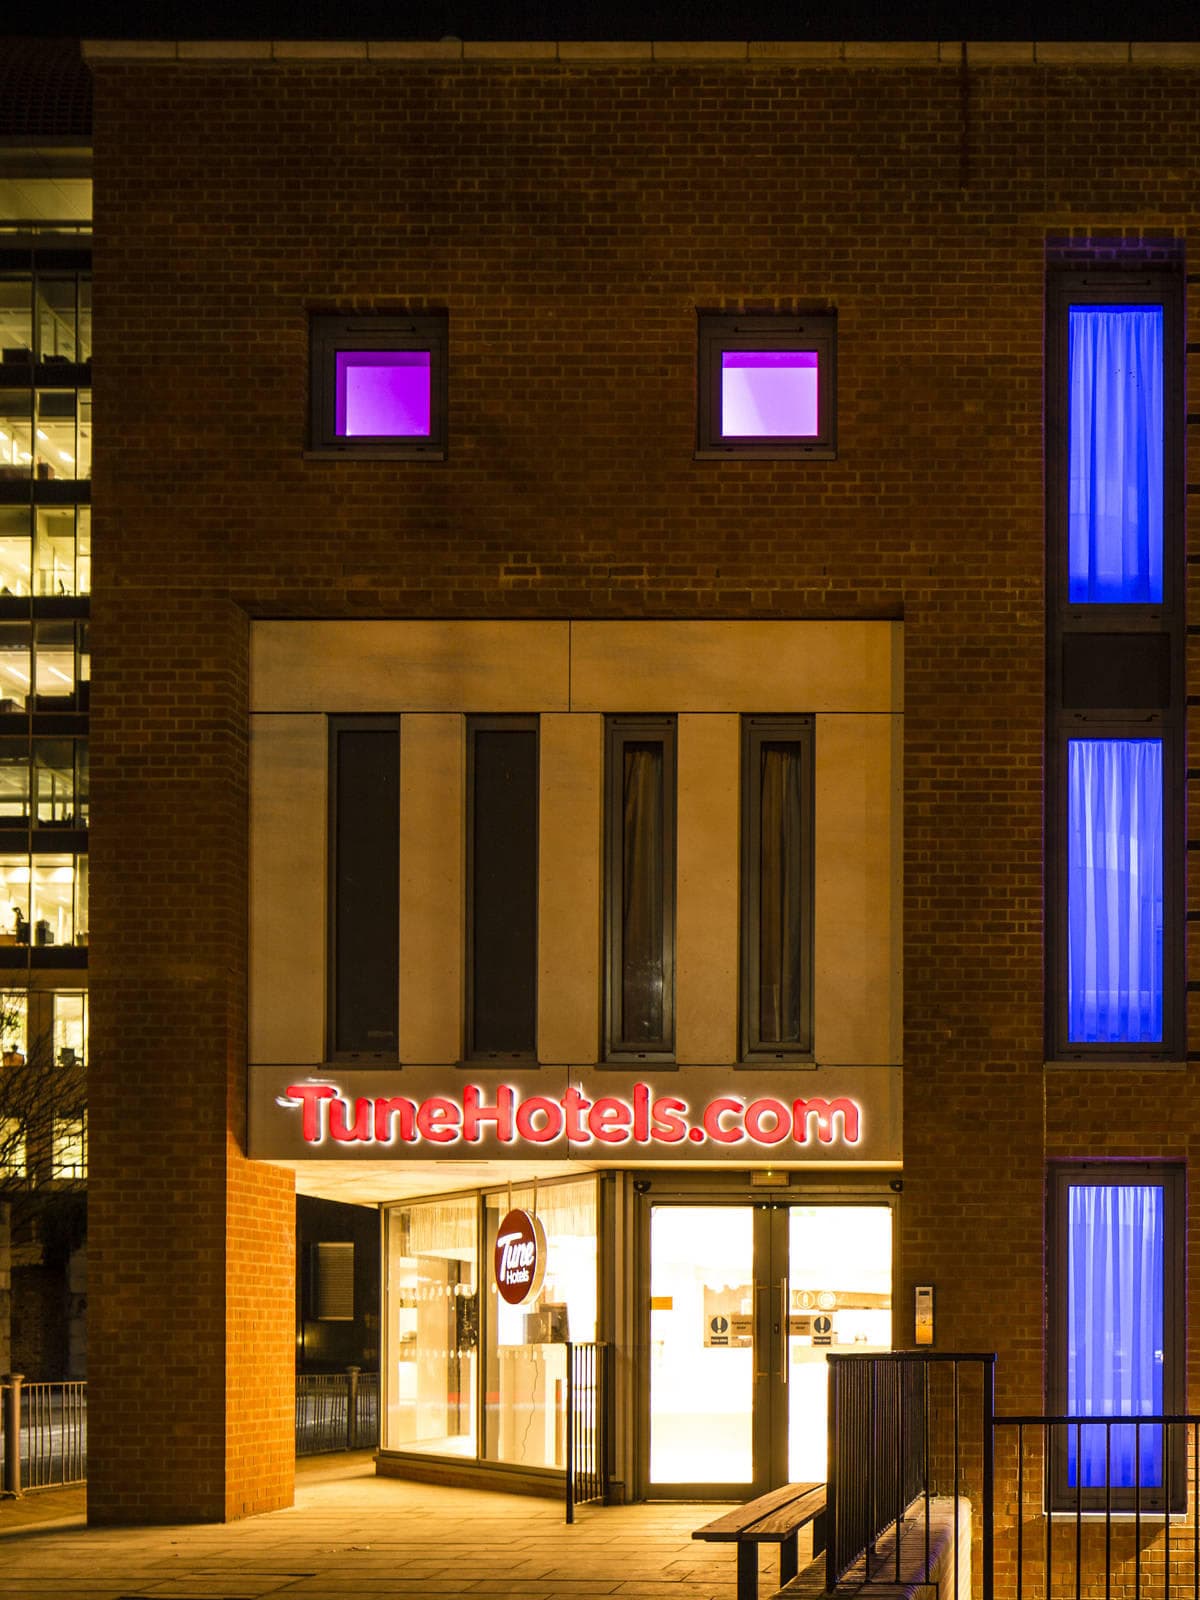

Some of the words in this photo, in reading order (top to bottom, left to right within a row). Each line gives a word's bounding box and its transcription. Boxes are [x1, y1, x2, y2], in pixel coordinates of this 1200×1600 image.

[284, 1083, 861, 1144] TuneHotels.com
[497, 1232, 535, 1282] Tune
[506, 1267, 530, 1285] Hotels
